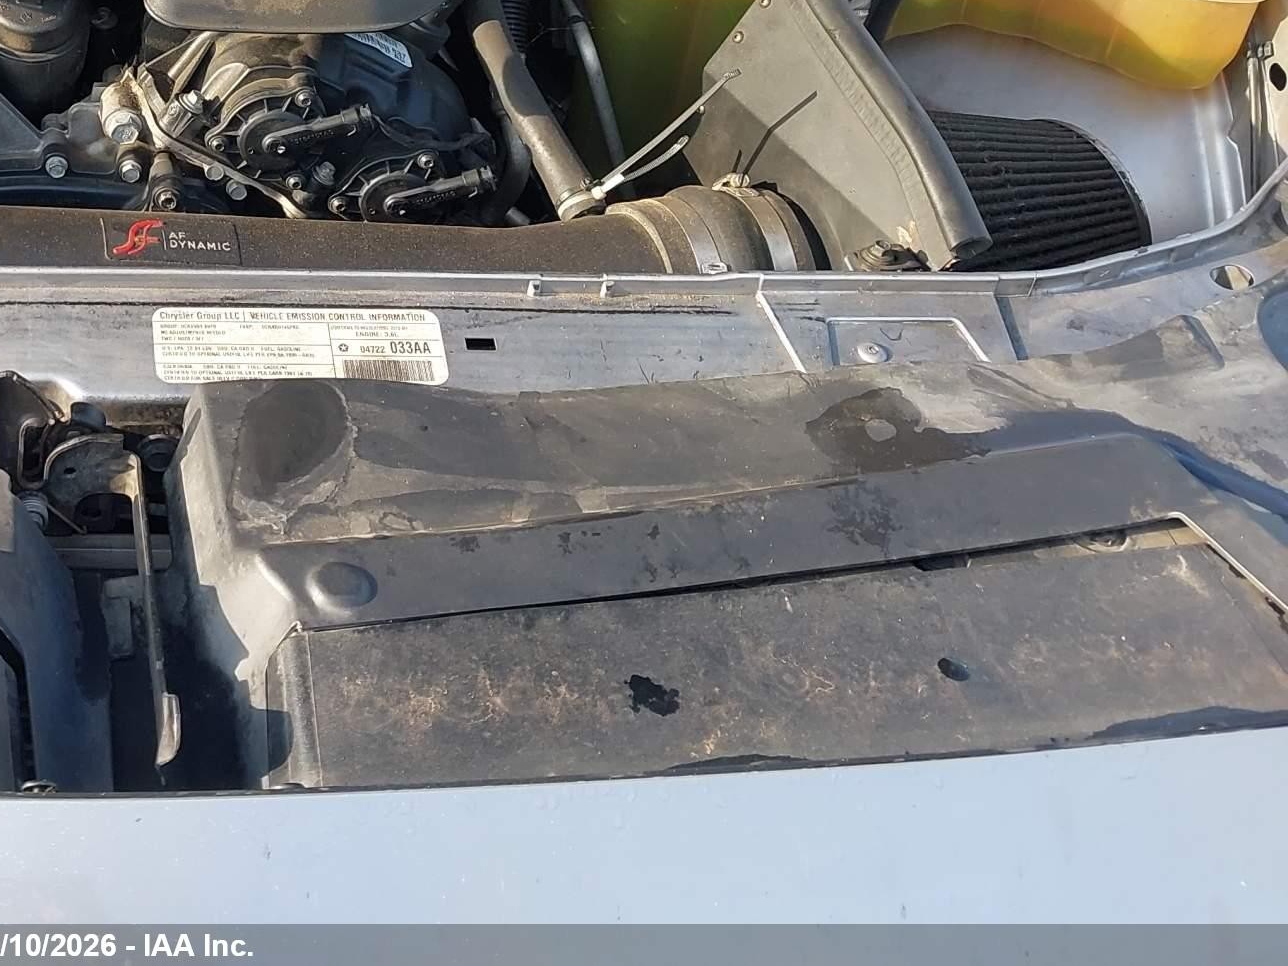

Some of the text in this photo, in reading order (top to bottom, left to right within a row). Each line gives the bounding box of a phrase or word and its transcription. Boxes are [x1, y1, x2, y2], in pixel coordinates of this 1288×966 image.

[168, 231, 187, 240] AF
[169, 240, 231, 251] DYNAMIC
[159, 311, 241, 322] Chrysler Group LLC
[249, 312, 426, 322] VEHICLE EMISSION CONTROL INFORMATION
[359, 341, 432, 355] 04722 033AA
